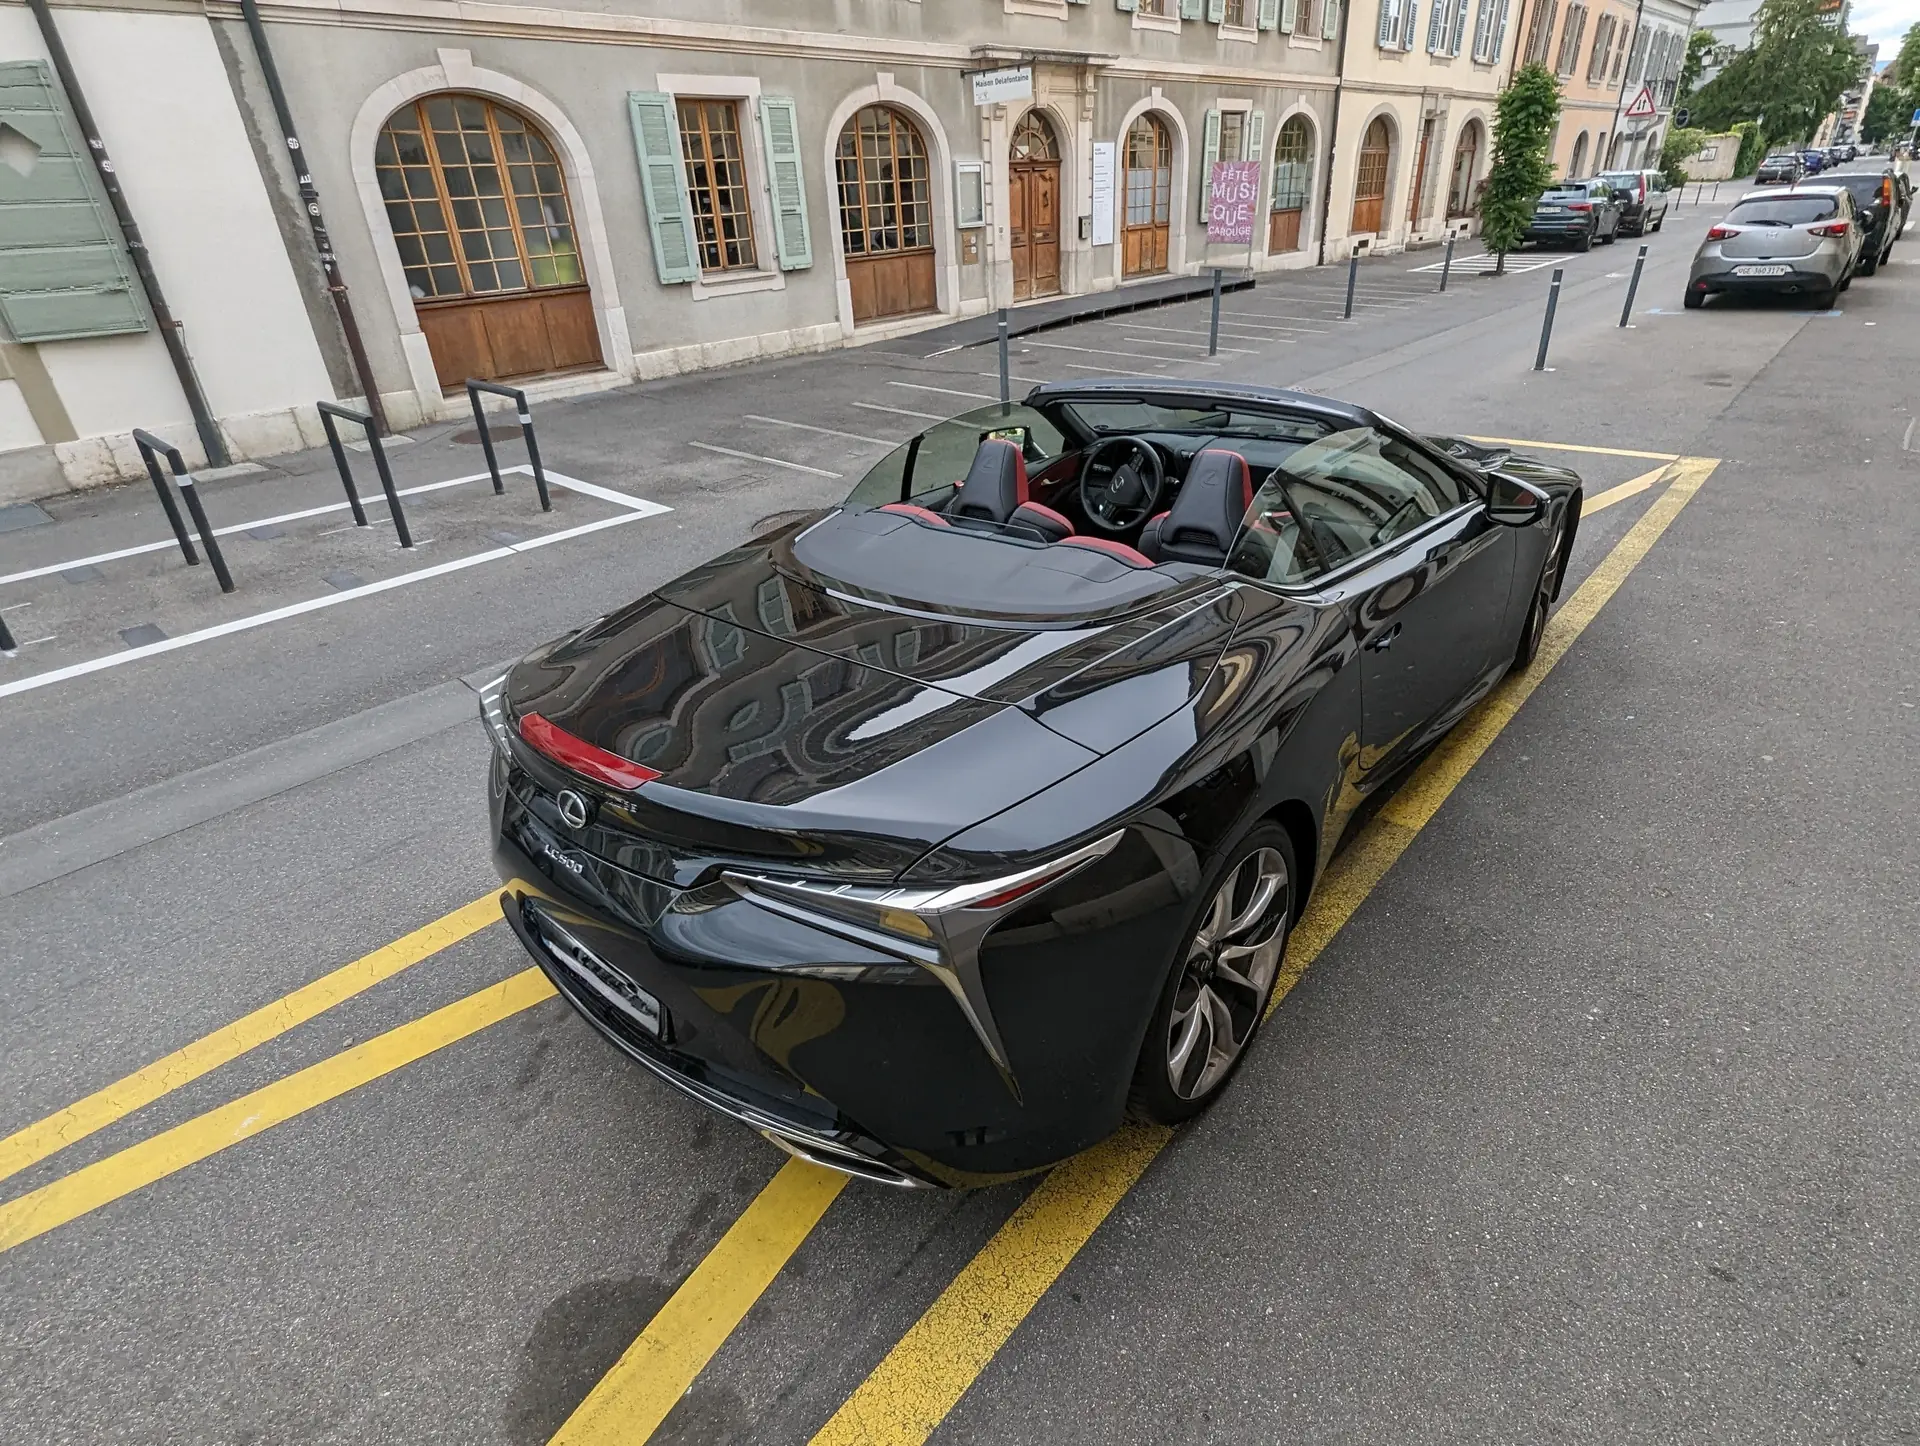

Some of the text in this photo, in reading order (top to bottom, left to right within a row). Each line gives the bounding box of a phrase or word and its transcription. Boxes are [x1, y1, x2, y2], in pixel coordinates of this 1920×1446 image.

[975, 74, 1029, 88] Maison Delafontaine
[1221, 167, 1249, 181] FÊTE
[1212, 182, 1256, 203] MUSI
[1213, 204, 1248, 226] QUE
[1208, 226, 1251, 236] CAROUGE
[544, 844, 584, 874] LC500
